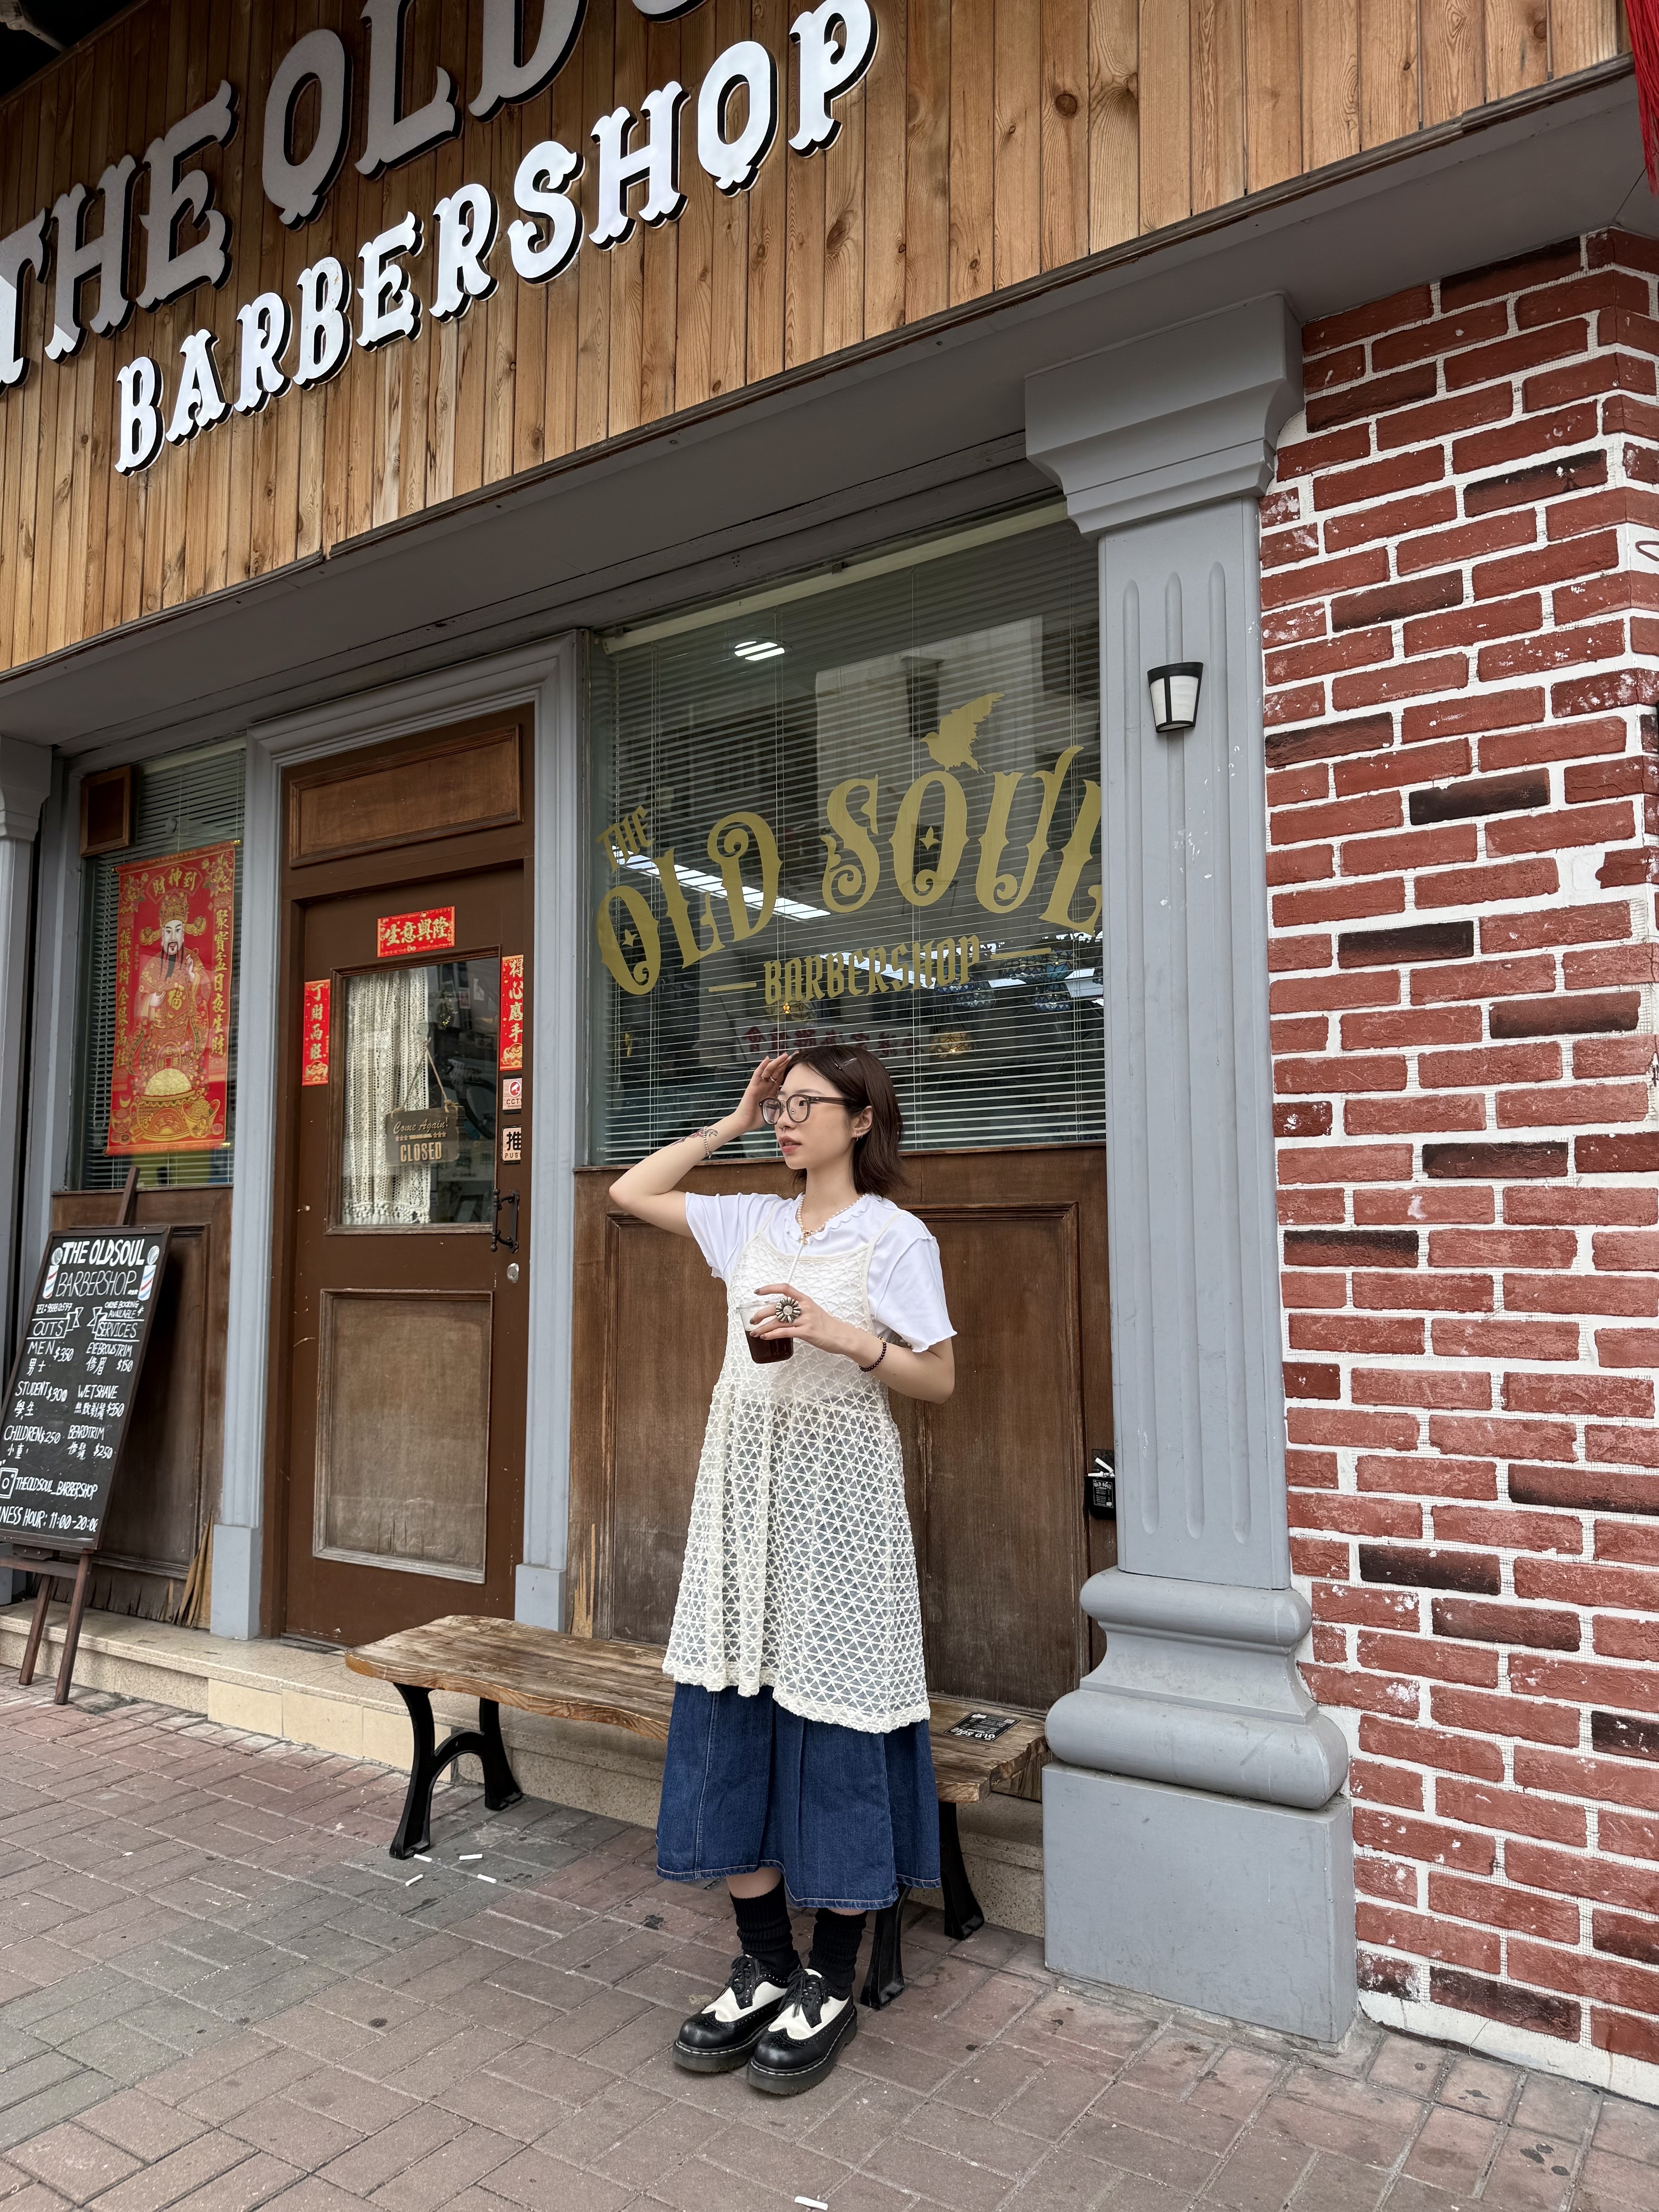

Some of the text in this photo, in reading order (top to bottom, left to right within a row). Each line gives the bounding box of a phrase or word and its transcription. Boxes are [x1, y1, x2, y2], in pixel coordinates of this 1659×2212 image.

[116, 0, 877, 476] BARBERSHOP
[596, 805, 654, 874] THE
[596, 745, 1102, 995] OLD SOUL
[153, 867, 197, 896] 財神到
[385, 916, 449, 946] 生意興隆
[763, 934, 979, 1005] BARBERSHOP
[508, 958, 523, 1042] 得心應手
[393, 1116, 448, 1134] Come Again!
[400, 1142, 442, 1162] CLOSED
[62, 1241, 90, 1264] THE
[55, 1270, 137, 1297] BARBERSHOP
[33, 1321, 64, 1336] CUTS
[97, 1323, 138, 1338] SERVICES
[27, 1340, 74, 1362] MEN $350
[27, 1358, 46, 1376] 男士
[86, 1356, 133, 1375] 修眉 $150
[15, 1381, 67, 1402] STUDENT $300
[14, 1400, 34, 1417] 學生
[4, 1425, 60, 1444] CHILDREN $250
[7, 1443, 24, 1459] 小童
[93, 1443, 113, 1459] $250
